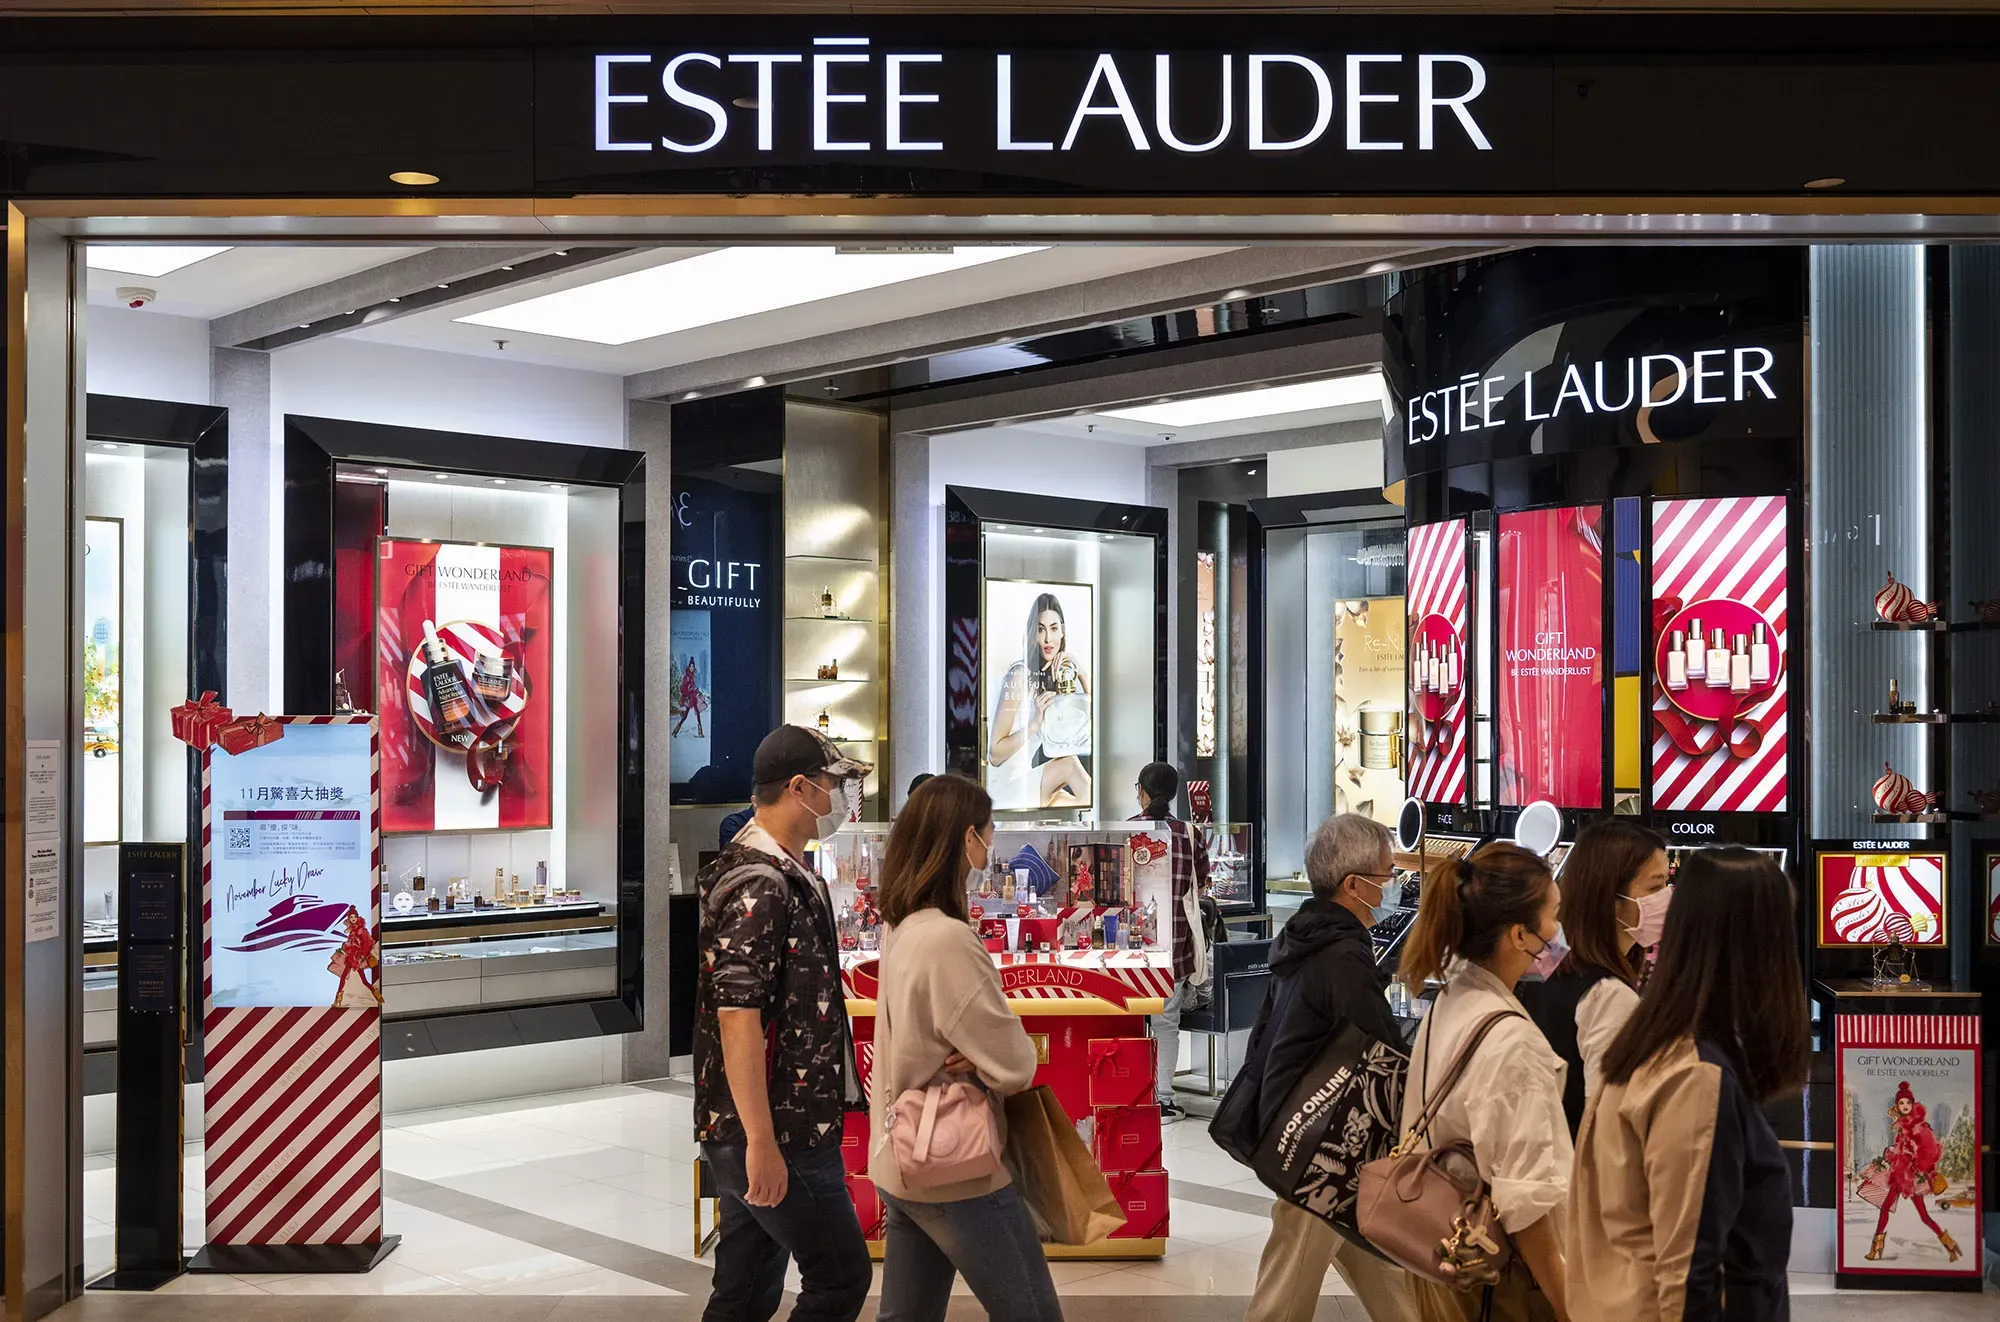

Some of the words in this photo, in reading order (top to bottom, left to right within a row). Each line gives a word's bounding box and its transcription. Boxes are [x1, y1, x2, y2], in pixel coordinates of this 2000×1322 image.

[997, 53, 1493, 152] LAUDER
[1524, 346, 1777, 422] LAUDER
[404, 563, 434, 577] GIFT
[437, 566, 532, 582] WONDERLAND
[688, 559, 760, 590] GIFT
[687, 595, 761, 608] BEAUTIFULLY
[1535, 631, 1564, 645] GIFT
[1505, 646, 1597, 662] WONDERLAND
[450, 734, 470, 743] NEW
[1671, 822, 1715, 834] COLOR
[1877, 841, 1910, 849] LAUDER
[226, 878, 267, 913] November
[269, 867, 295, 898] Lucky
[297, 861, 324, 891] Draw
[1857, 1055, 1880, 1066] GIFT
[1882, 1056, 1960, 1066] WONDERLAND
[1866, 1068, 1877, 1077] BE
[1899, 1068, 1949, 1077] WANDERLUST
[1277, 1112, 1303, 1154] SHOP
[1302, 1065, 1352, 1114] ONLINE
